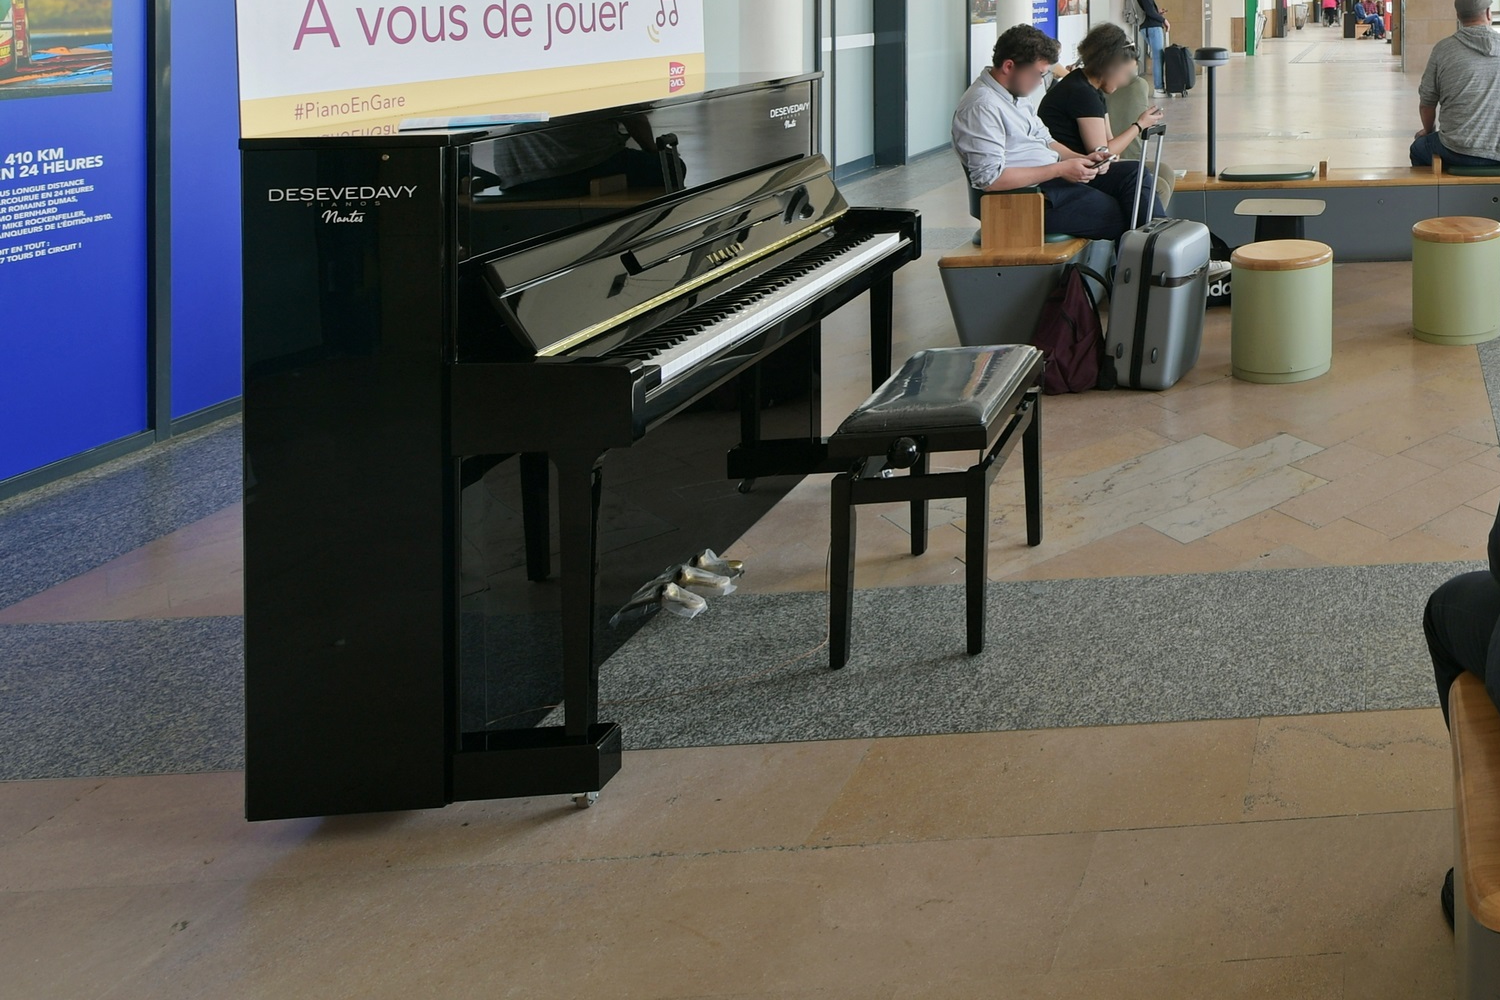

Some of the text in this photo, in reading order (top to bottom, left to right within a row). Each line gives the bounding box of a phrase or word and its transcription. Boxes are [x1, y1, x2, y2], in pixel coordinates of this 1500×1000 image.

[356, 4, 468, 46] vous
[670, 66, 685, 75] SNCF
[294, 94, 406, 121] #PianoEnGare
[770, 102, 810, 118] DESEVEDAVY
[4, 147, 64, 165] 410 KM
[0, 155, 103, 180] N 24 HEURES
[12, 185, 45, 195] LONGUE
[47, 179, 84, 190] DISTANCE
[65, 185, 94, 195] HEURES
[268, 185, 418, 202] DESEVEDAVY
[8, 201, 46, 212] ROMAINS
[14, 207, 58, 220] BERNHARD
[2, 211, 86, 230] MIKE ROCKENFELLER,
[57, 217, 92, 229] L'ÉDITION
[94, 213, 113, 222] 2010.
[321, 210, 366, 223] Nantes
[7, 252, 33, 264] TOURS
[48, 243, 77, 254] CIRCUIT
[24, 241, 46, 250] TOUT
